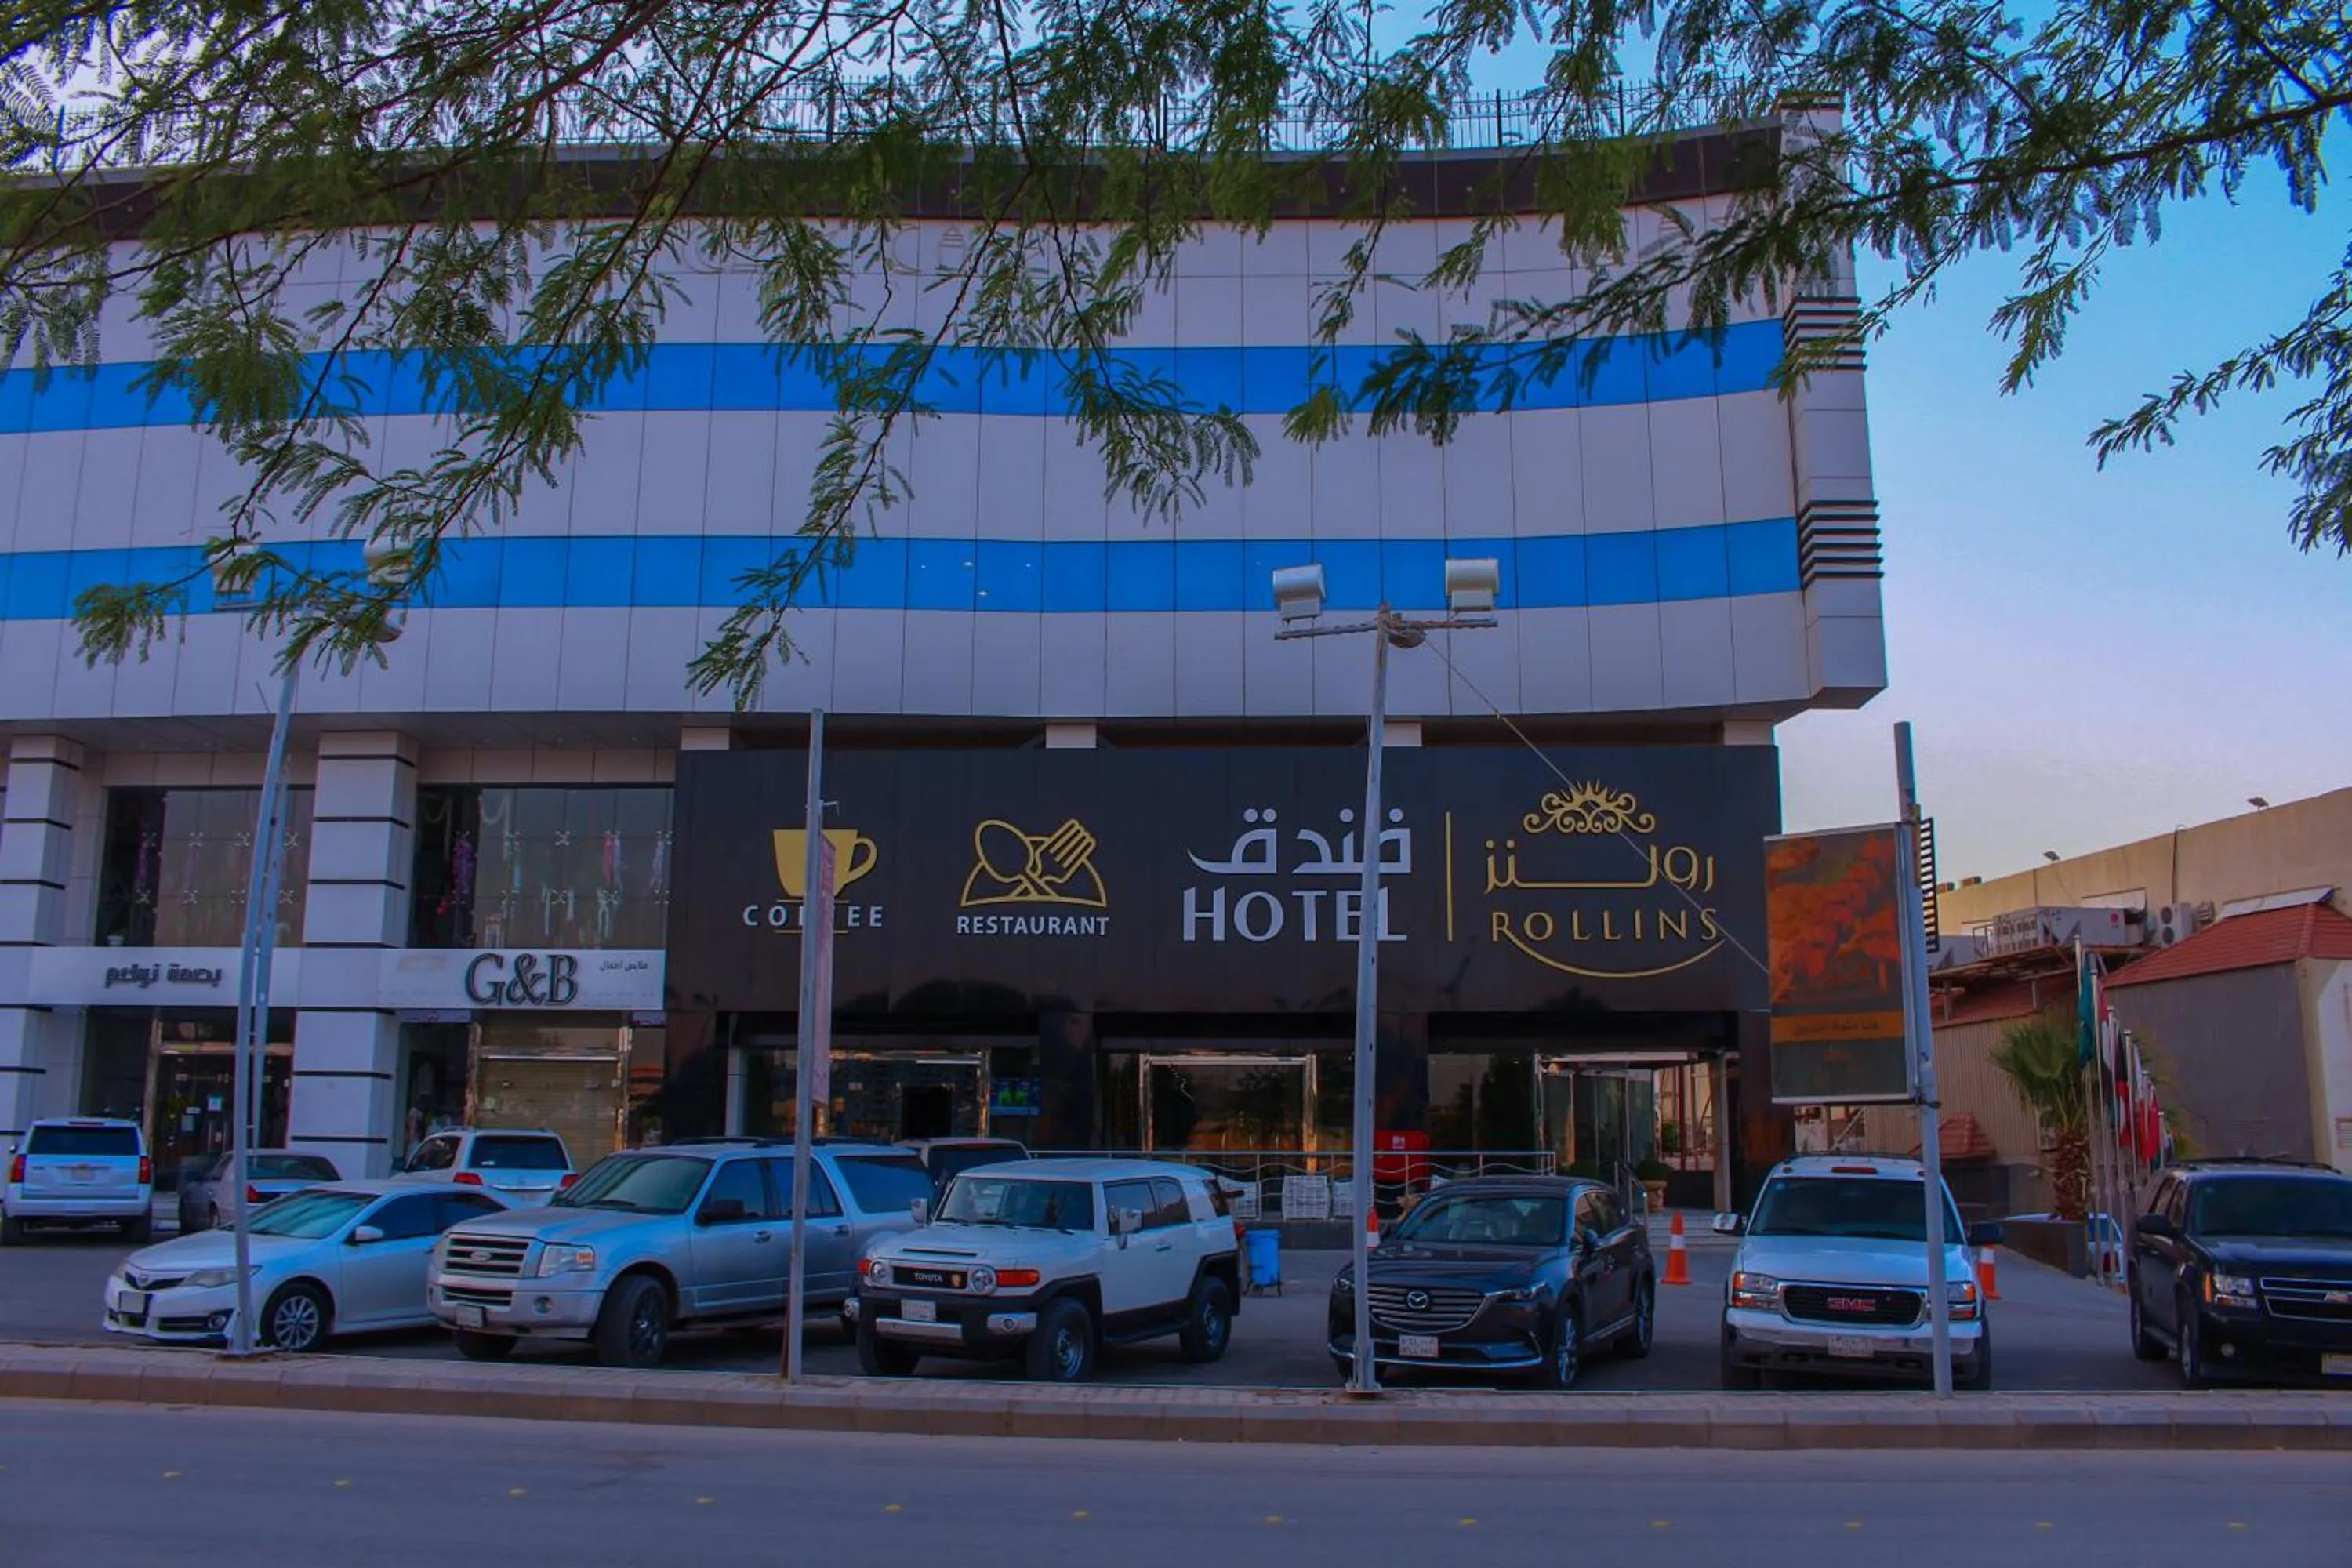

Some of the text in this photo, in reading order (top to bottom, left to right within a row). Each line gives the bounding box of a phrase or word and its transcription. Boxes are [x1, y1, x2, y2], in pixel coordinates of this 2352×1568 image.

[1186, 808, 1410, 873] فندق
[1484, 840, 1715, 895] رولنز
[742, 905, 883, 927] COEE
[956, 916, 1109, 935] RESTAURANT
[1183, 887, 1407, 941] HOTEL
[1491, 908, 1718, 943] ROLLINS
[464, 953, 578, 1005] G&B
[914, 1272, 943, 1283] TOYOTA
